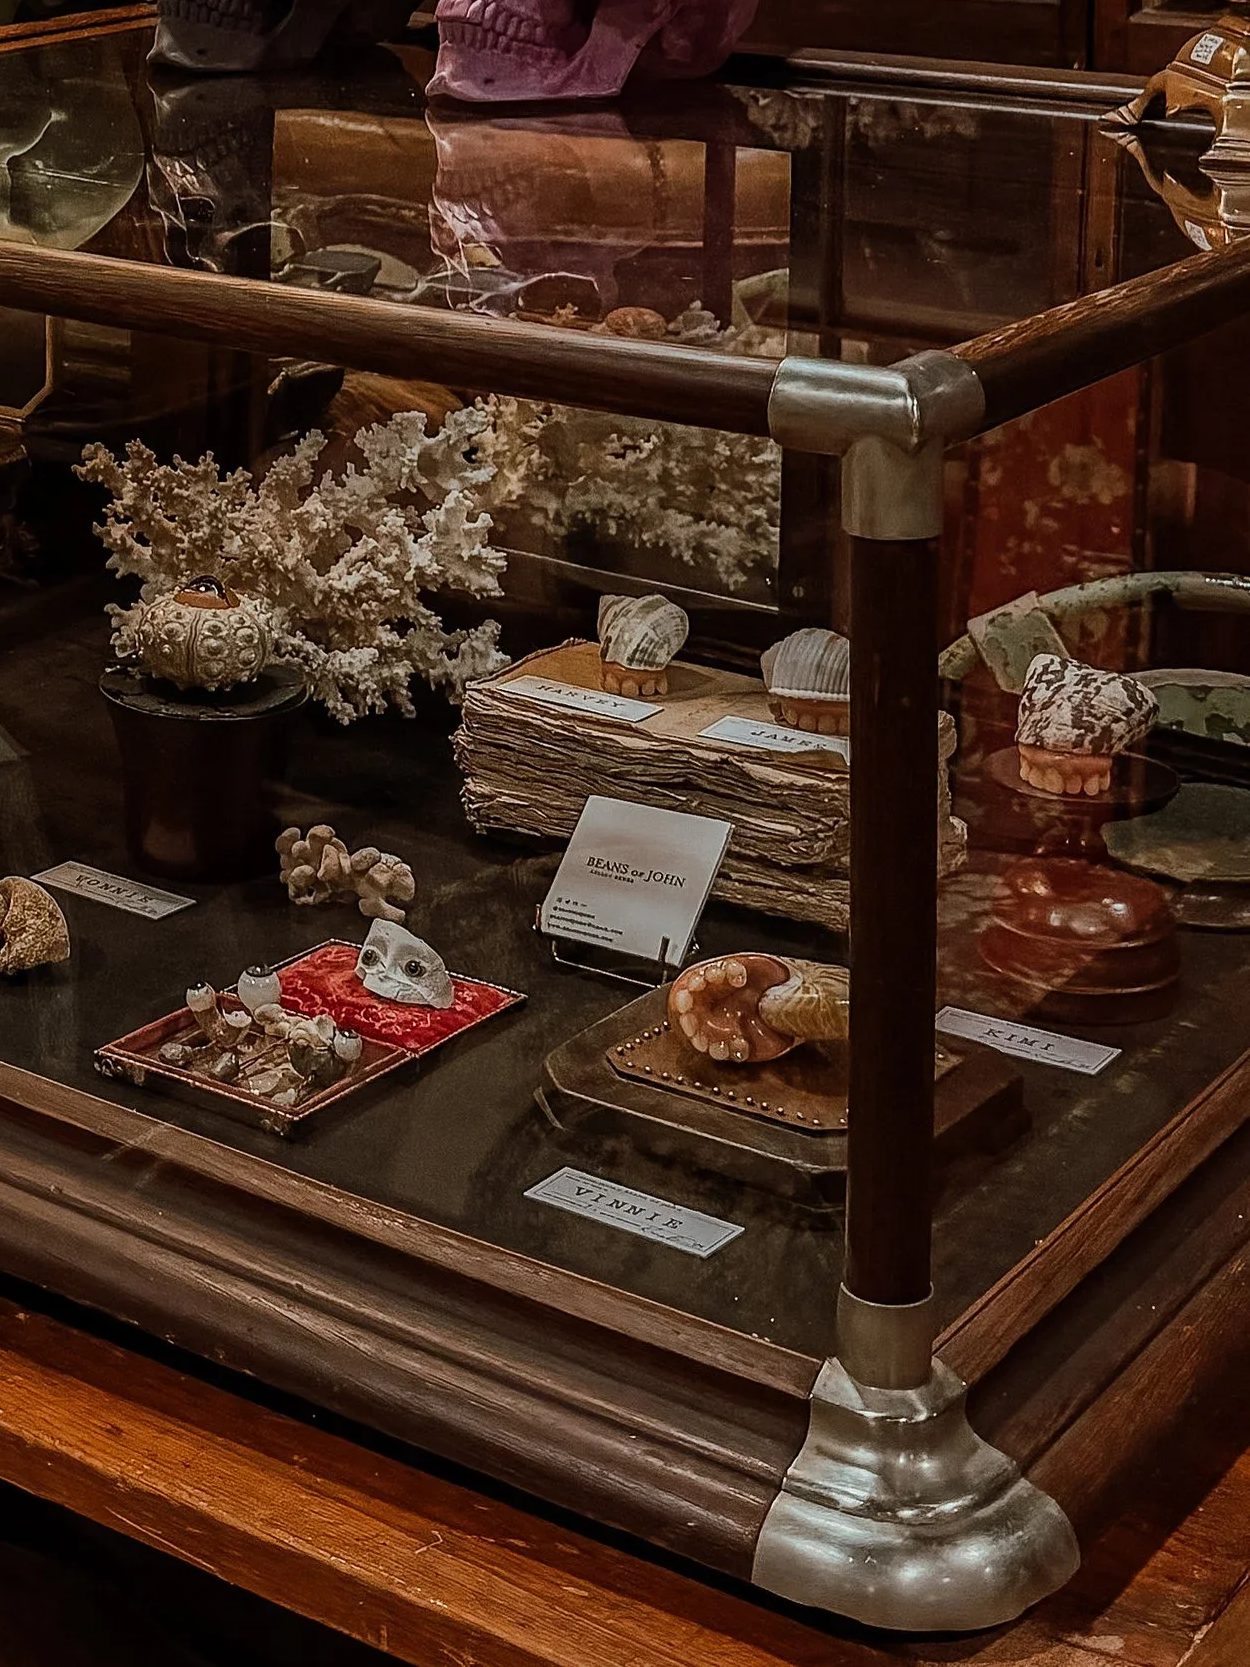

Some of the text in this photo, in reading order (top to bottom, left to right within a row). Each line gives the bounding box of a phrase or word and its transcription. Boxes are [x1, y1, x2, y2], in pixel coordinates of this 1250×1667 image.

[536, 684, 626, 708] HARVEY
[750, 730, 827, 751] JAMES
[587, 856, 629, 875] BEANS
[643, 870, 687, 888] JOHN
[983, 1028, 1055, 1051] KIMI
[574, 1185, 684, 1229] VINNIE
